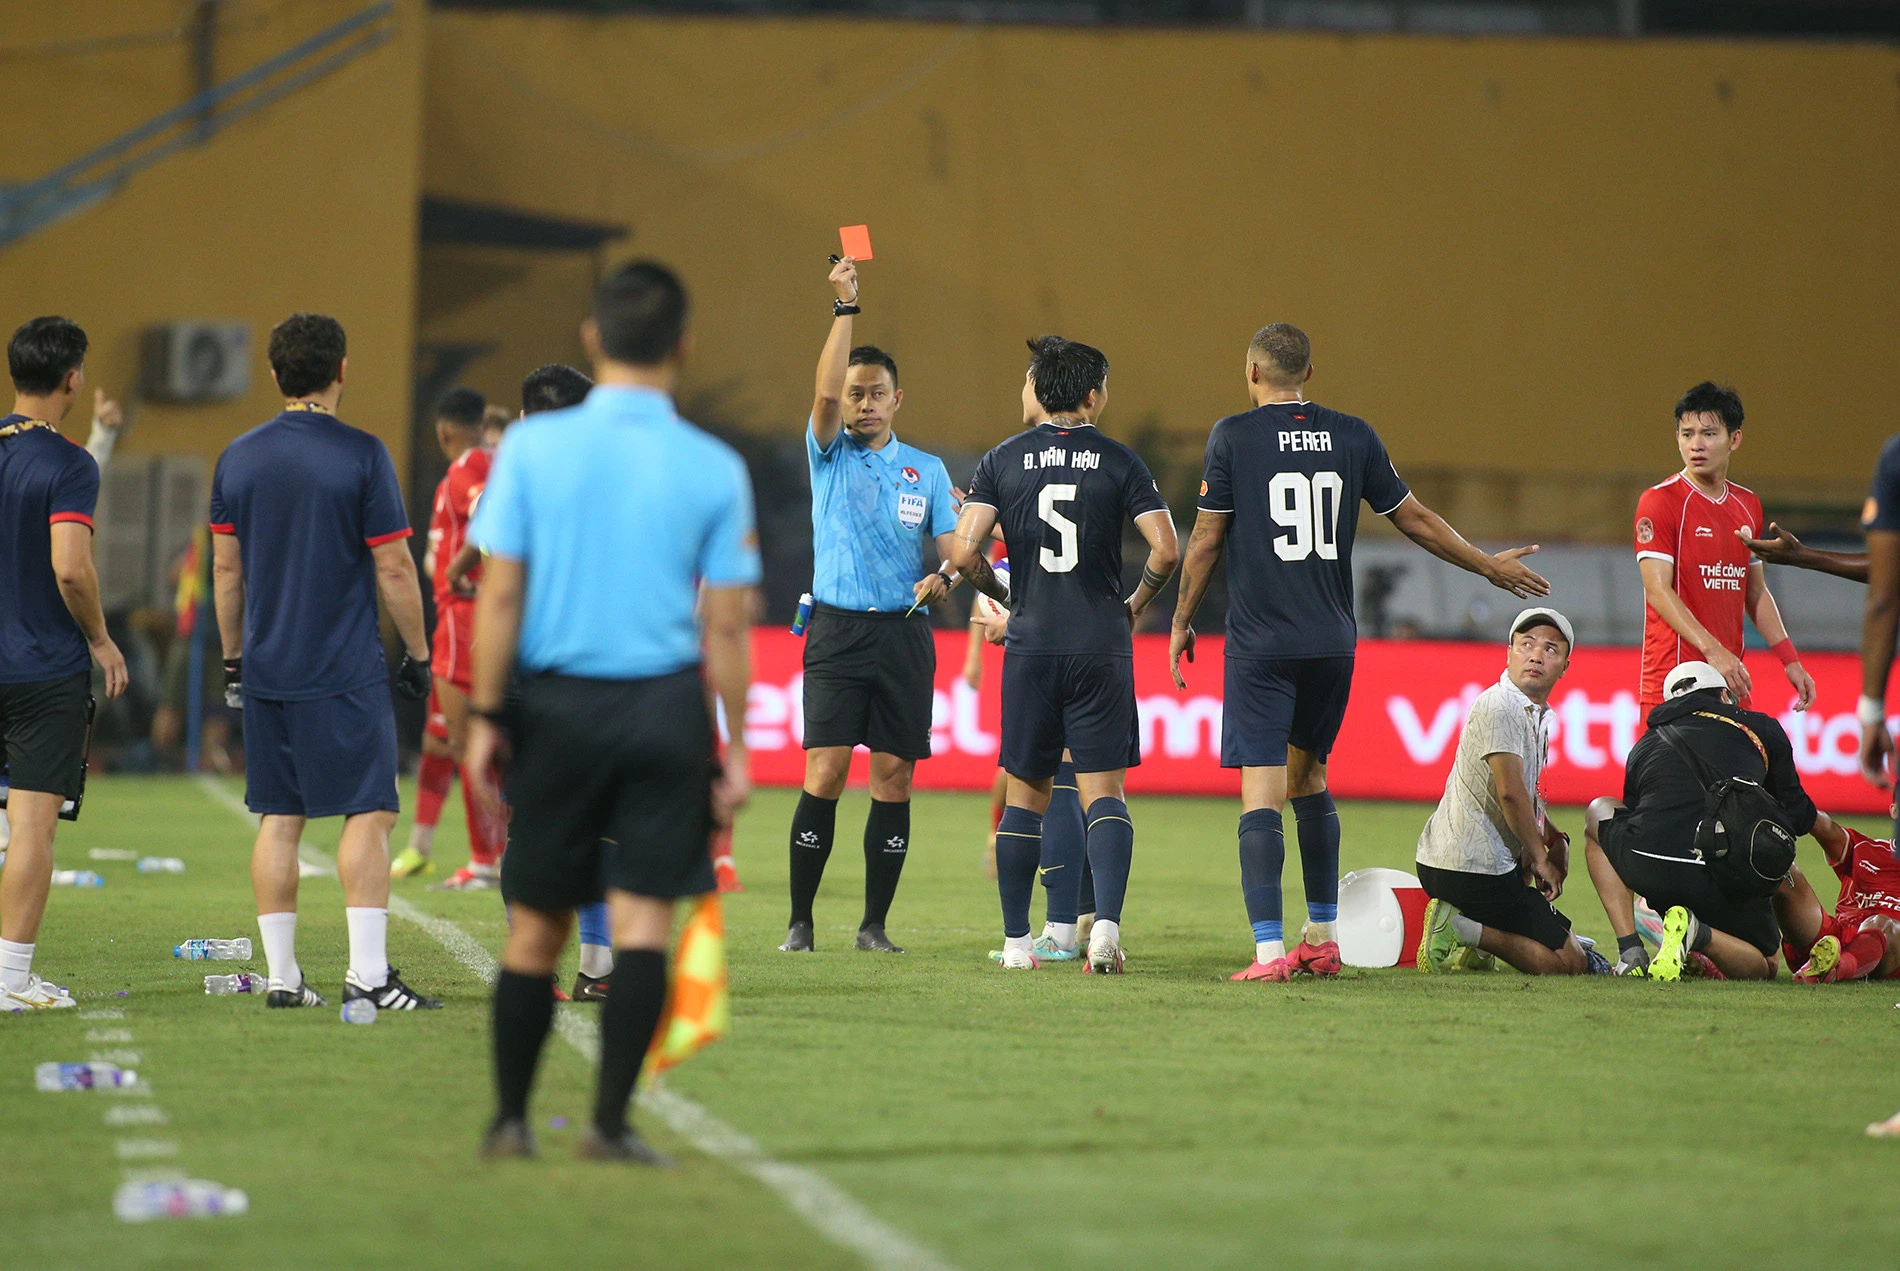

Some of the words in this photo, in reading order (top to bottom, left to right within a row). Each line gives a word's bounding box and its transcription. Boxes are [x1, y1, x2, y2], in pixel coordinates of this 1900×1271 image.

[1277, 430, 1332, 452] PEREA
[1071, 450, 1101, 471] HẬU
[901, 496, 924, 508] FIFA
[1268, 471, 1344, 562] 90
[1038, 483, 1079, 573] 5
[1722, 563, 1746, 578] CÔNG
[1703, 577, 1741, 591] VIETTEL
